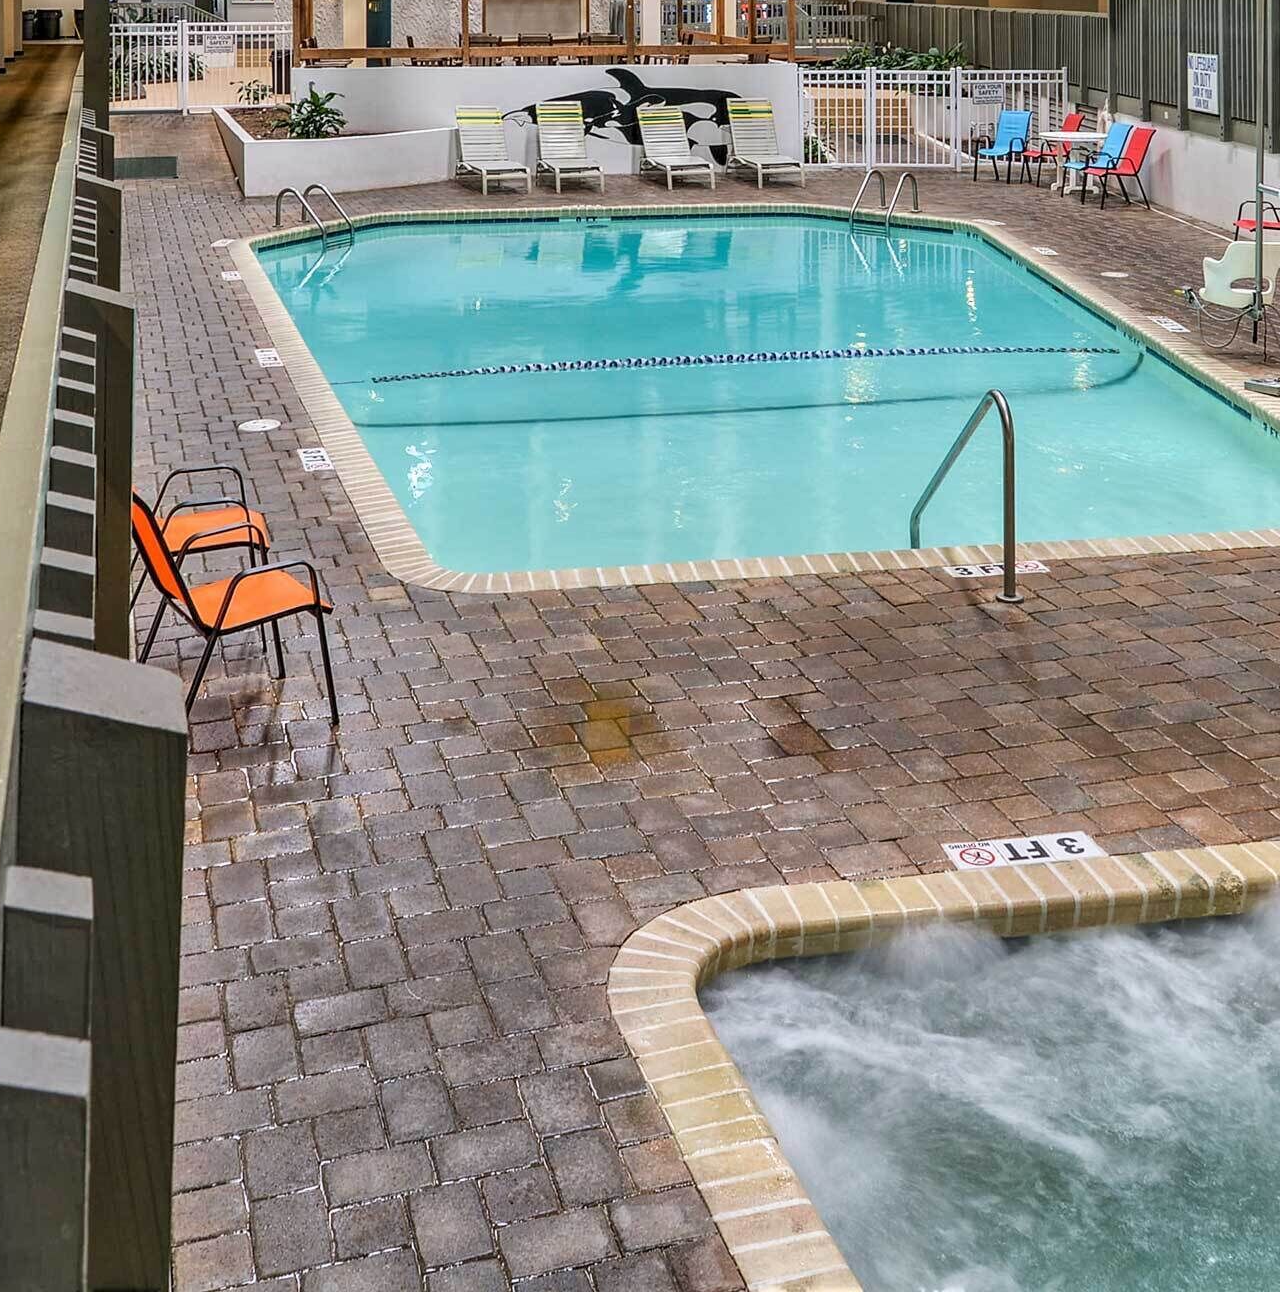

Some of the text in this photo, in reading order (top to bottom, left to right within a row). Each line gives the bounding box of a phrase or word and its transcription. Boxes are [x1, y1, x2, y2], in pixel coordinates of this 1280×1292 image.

[955, 567, 974, 576] 3
[1004, 837, 1085, 861] 3 FT
